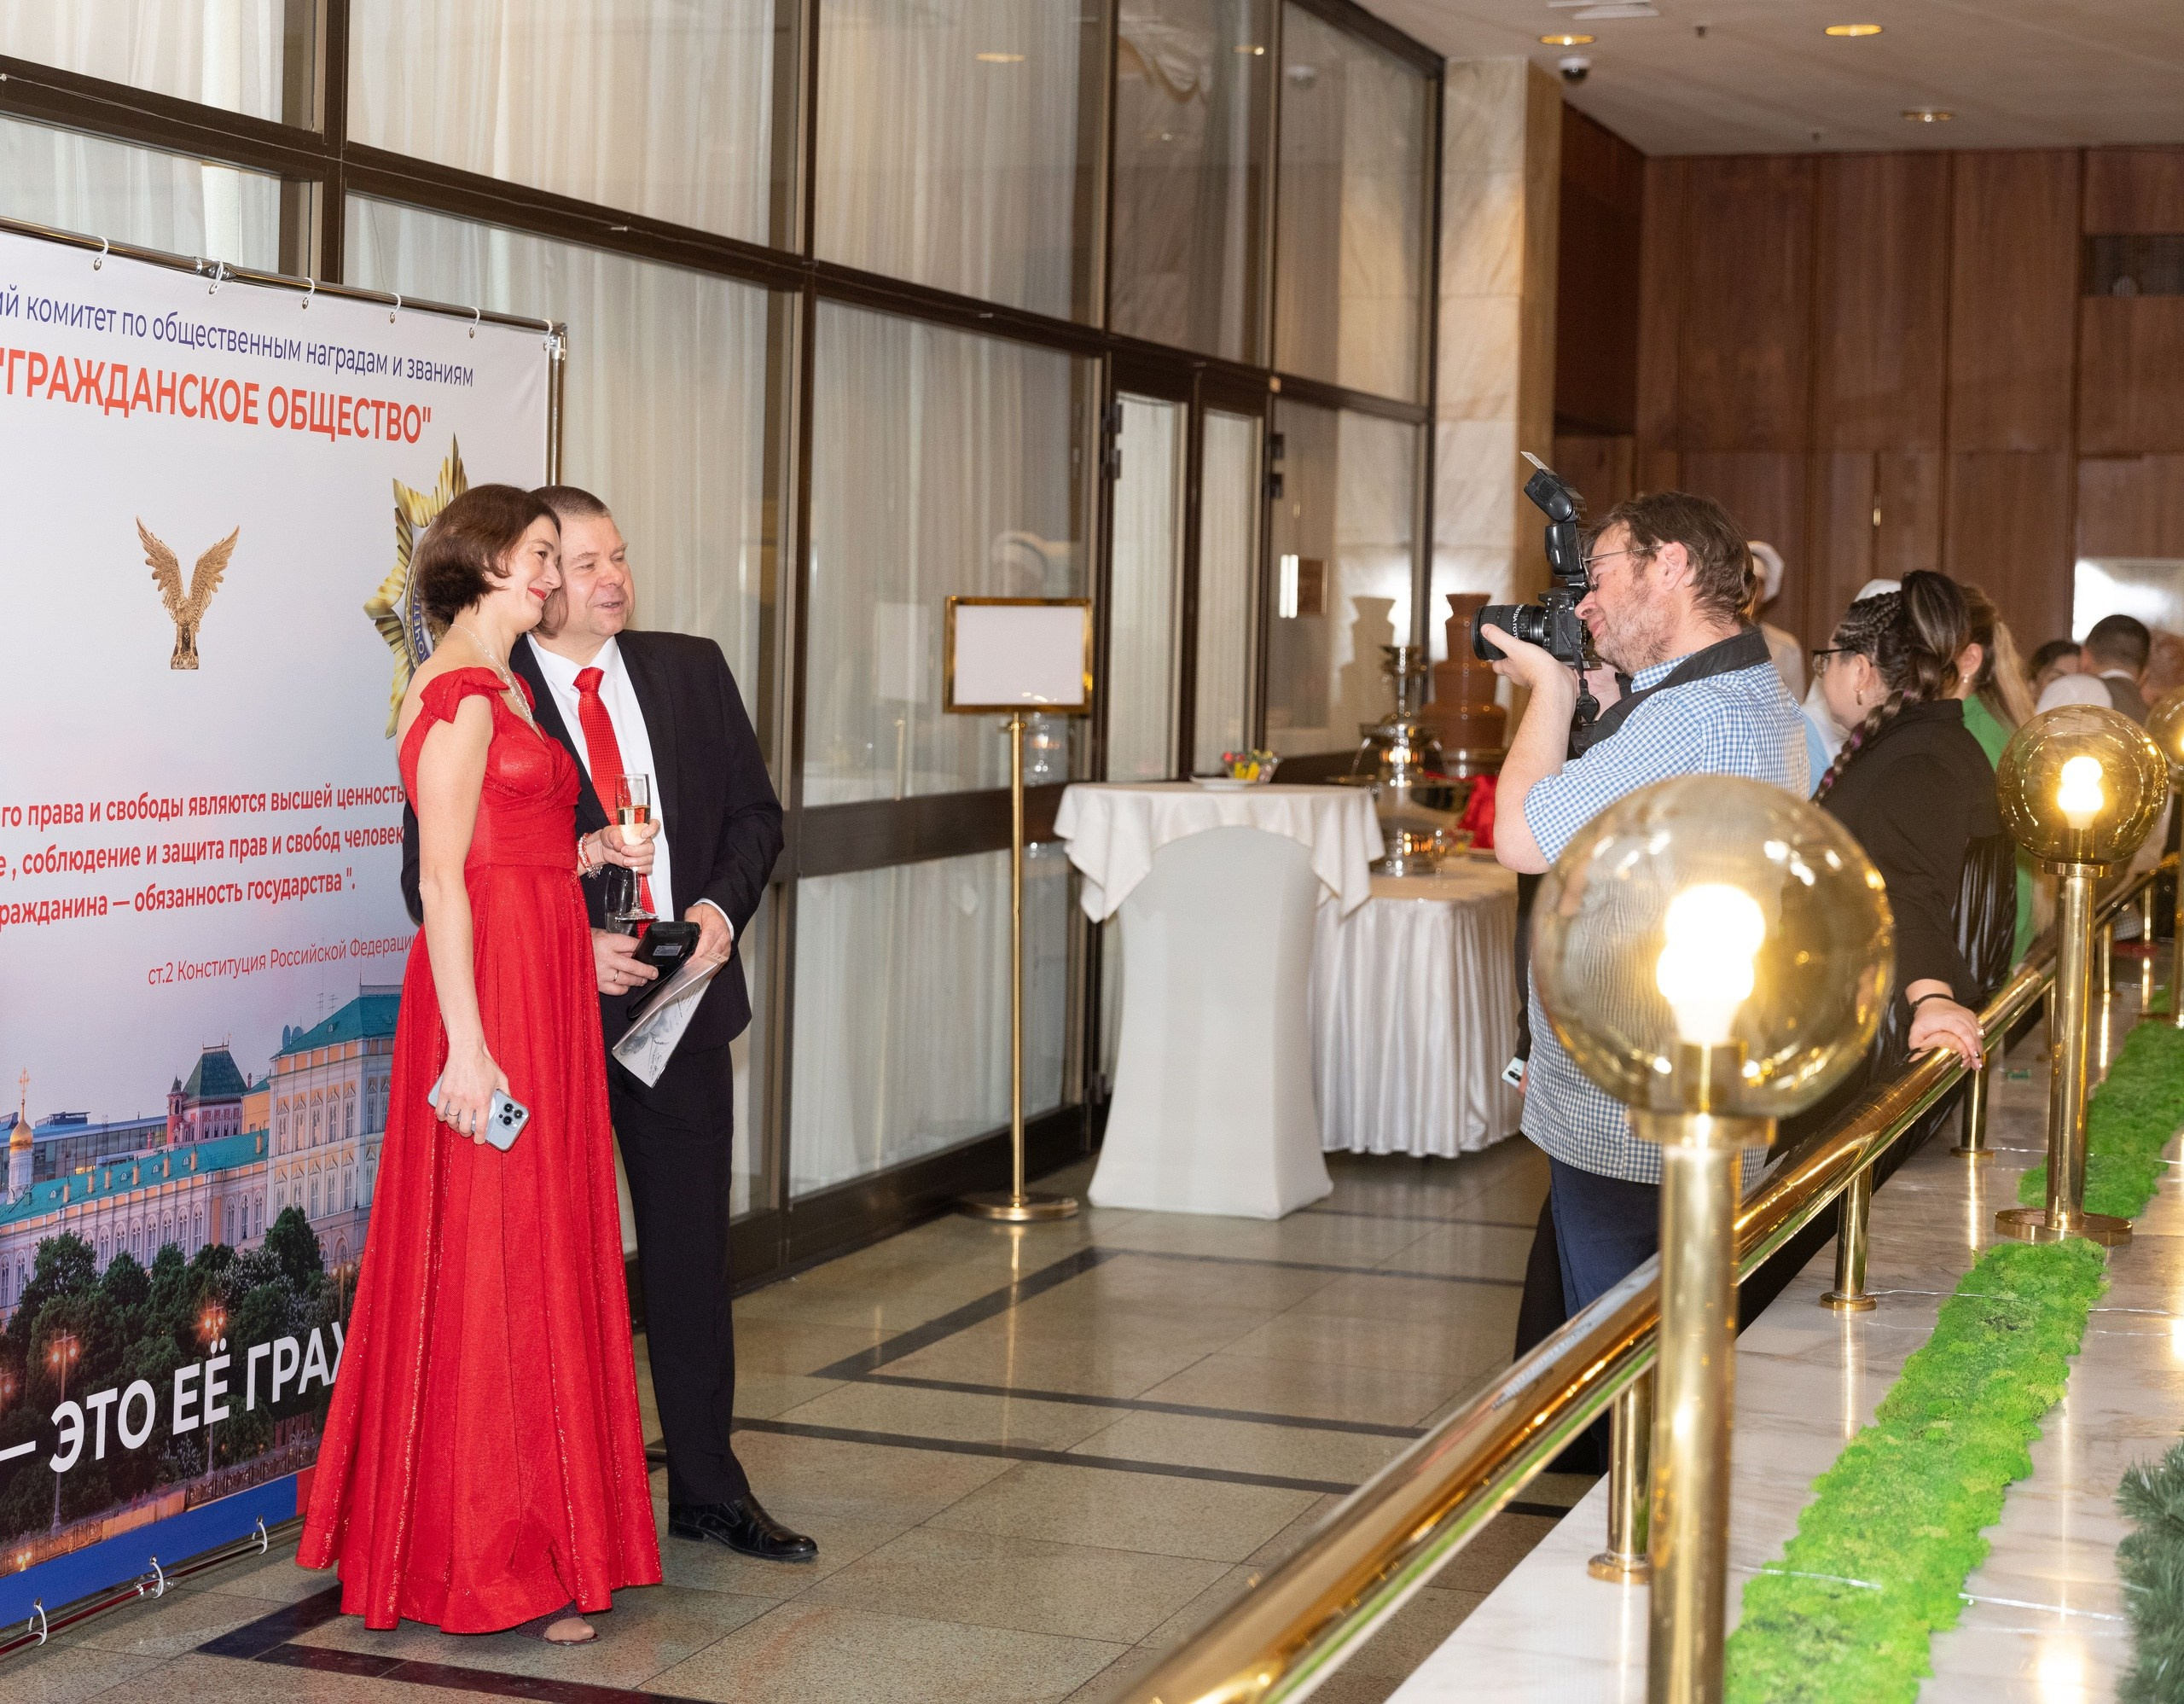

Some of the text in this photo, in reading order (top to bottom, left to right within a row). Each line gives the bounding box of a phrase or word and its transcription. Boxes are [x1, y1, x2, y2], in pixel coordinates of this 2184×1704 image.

[0, 284, 473, 387] й комитет по общественным наградам и званиям
[268, 386, 432, 444] ОБЩЕСТВО"
[28, 802, 84, 832] права
[89, 801, 102, 823] и
[105, 792, 183, 823] свободы
[189, 793, 266, 817] являются
[270, 783, 333, 811] высшей
[337, 785, 407, 810] ценность
[21, 843, 141, 875] соблюдение
[146, 845, 158, 865] и
[162, 838, 224, 865] защита
[229, 836, 267, 862] прав
[272, 835, 282, 855] и
[286, 825, 340, 853] свобод
[134, 882, 242, 913] обязанность
[247, 872, 342, 906] государства
[148, 935, 415, 986] ст.2 Конституция Российской Федераци
[49, 1379, 156, 1473] ЭТО
[172, 1338, 230, 1435] ЕЁ
